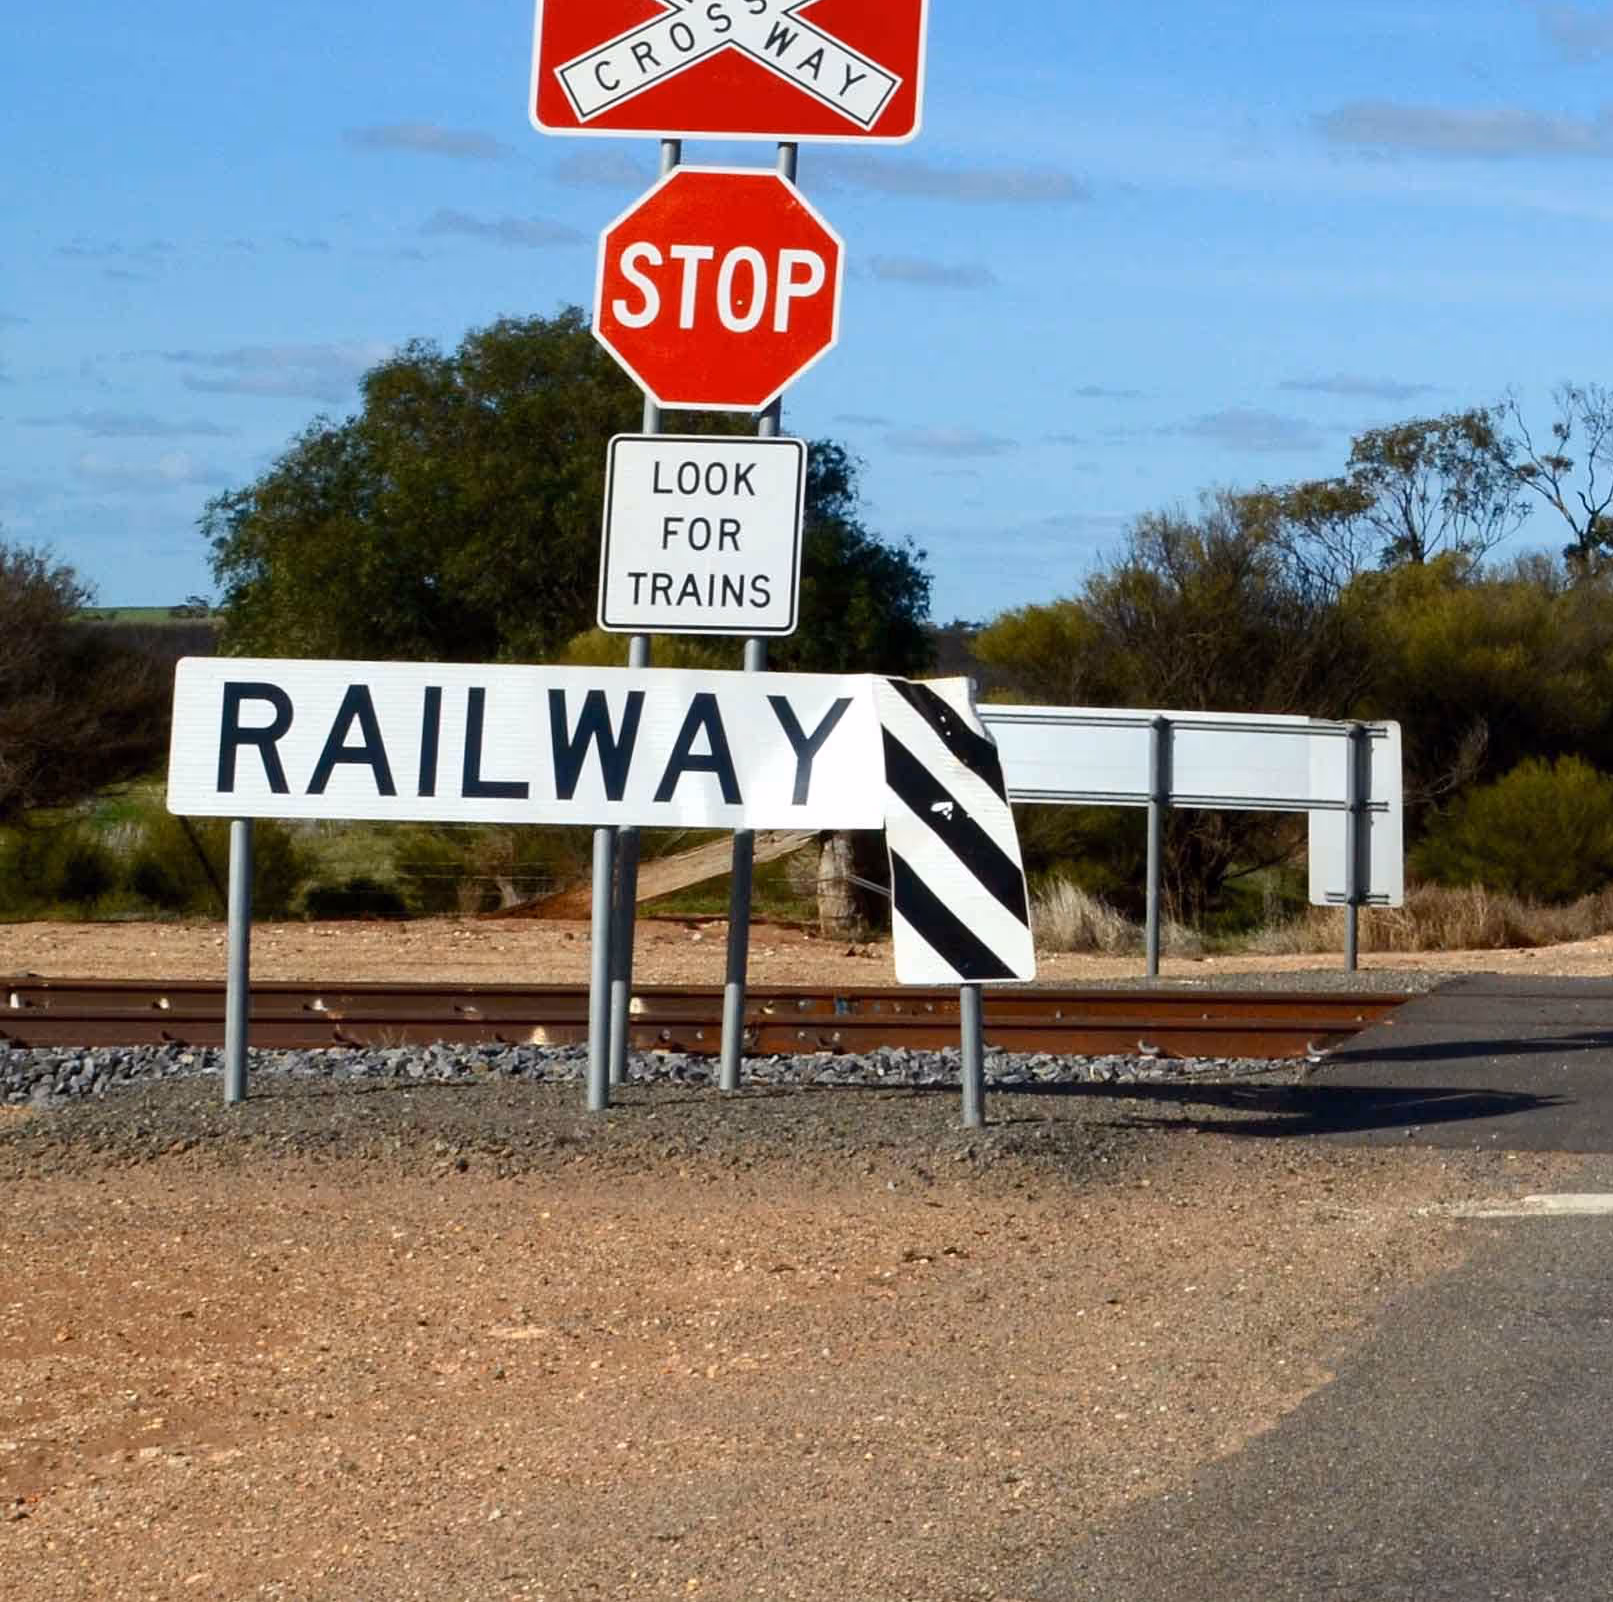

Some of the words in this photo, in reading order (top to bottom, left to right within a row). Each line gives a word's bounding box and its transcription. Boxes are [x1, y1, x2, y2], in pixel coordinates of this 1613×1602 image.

[764, 21, 867, 97] WAY
[612, 241, 826, 333] STOP
[653, 461, 757, 496] LOOK
[662, 517, 741, 551] FOR
[627, 572, 771, 609] TRAINS
[217, 681, 853, 805] RAILWAY
